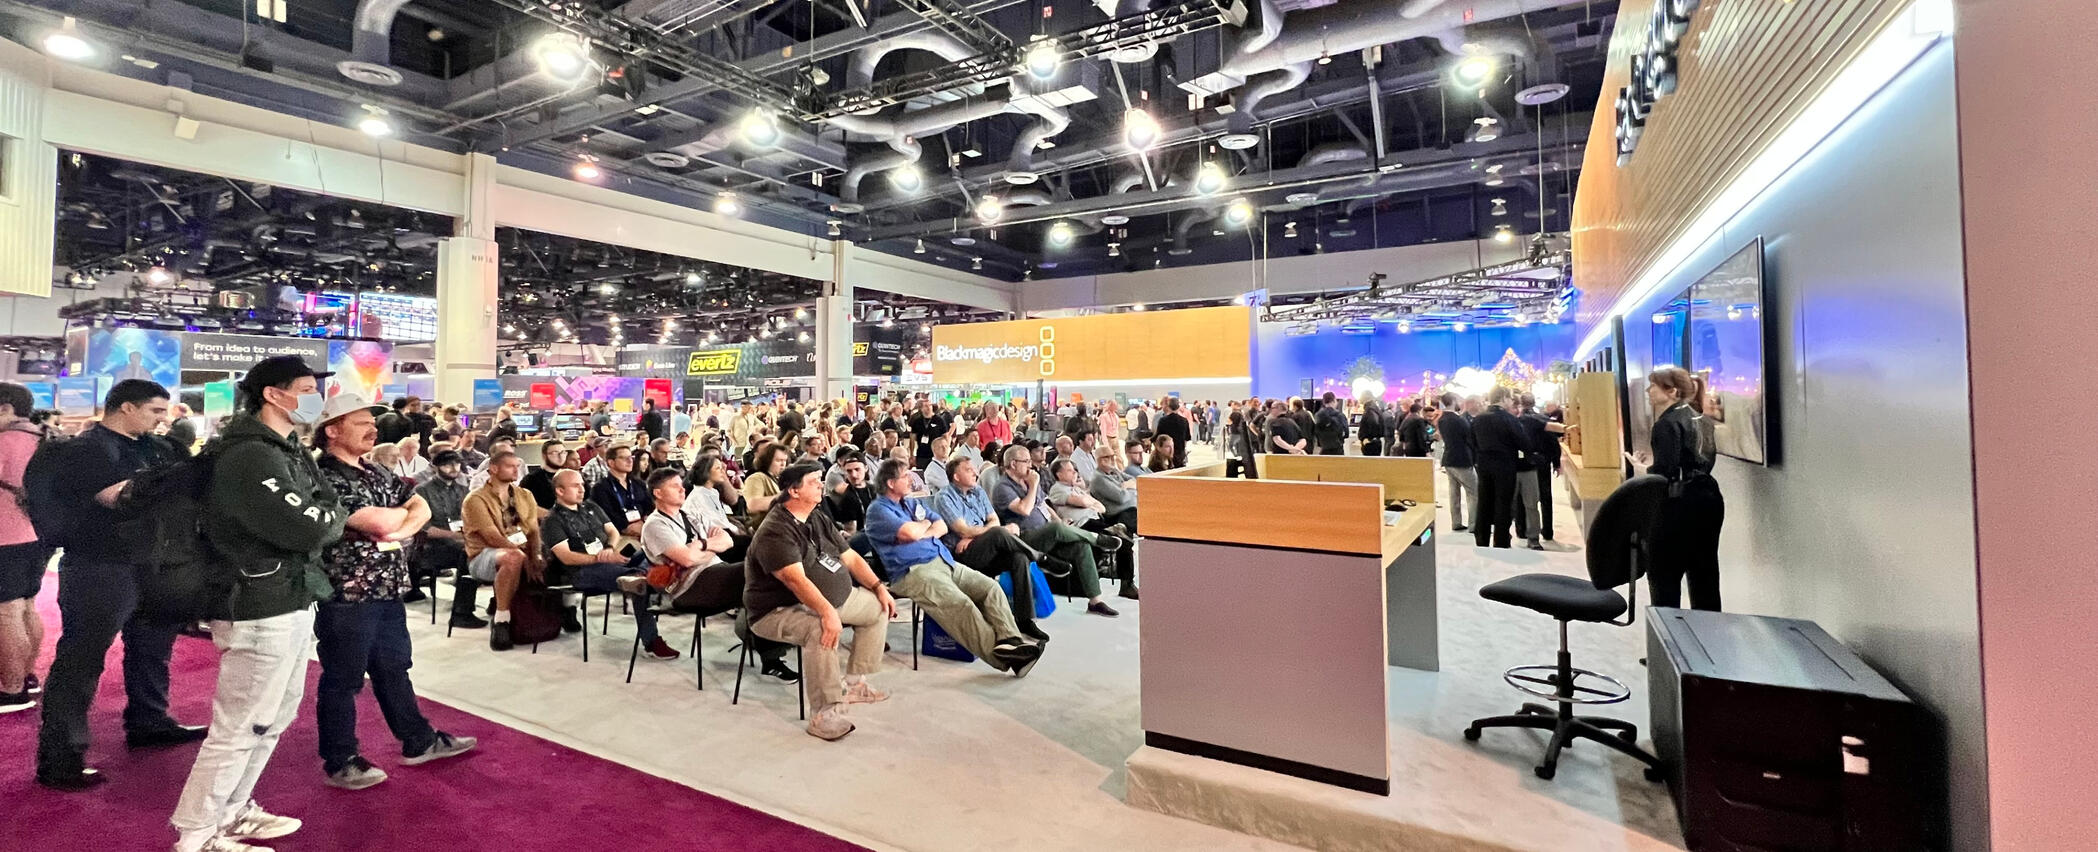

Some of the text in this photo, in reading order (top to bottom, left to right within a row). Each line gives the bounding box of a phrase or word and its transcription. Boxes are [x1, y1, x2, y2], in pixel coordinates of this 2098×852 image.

[193, 342, 318, 357] From idea to audience,
[193, 352, 220, 361] let's
[221, 353, 253, 362] make
[691, 354, 735, 371] evertz
